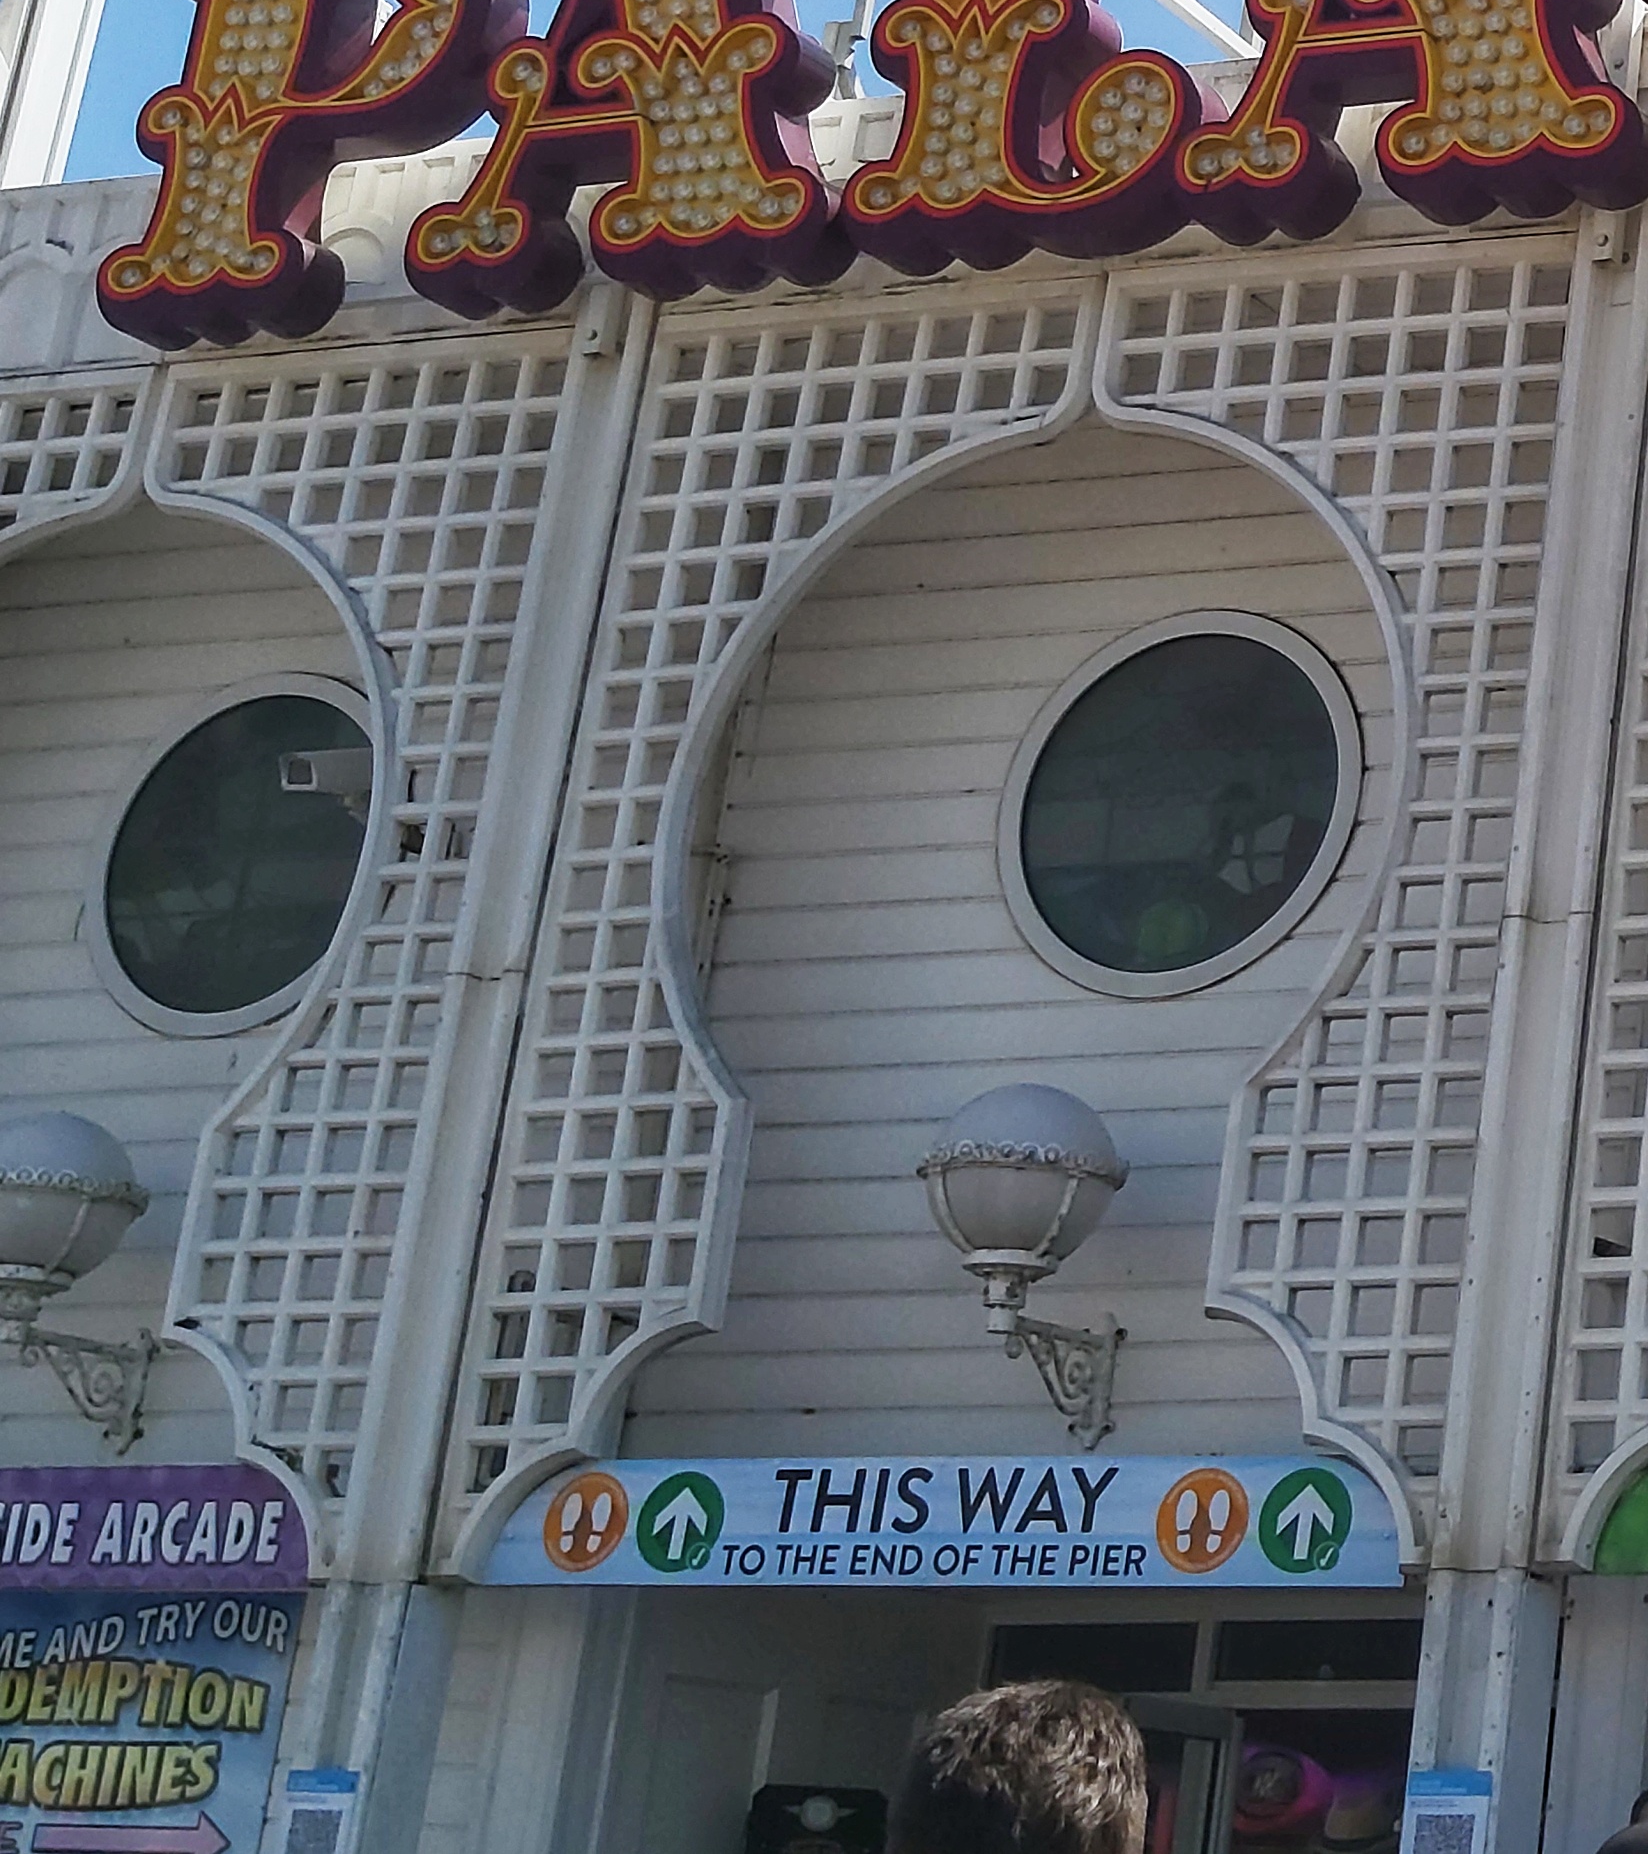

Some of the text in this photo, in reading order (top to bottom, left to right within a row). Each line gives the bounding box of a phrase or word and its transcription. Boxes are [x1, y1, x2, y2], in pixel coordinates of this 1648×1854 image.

[0, 1500, 285, 1564] IDE ARCADE
[775, 1466, 934, 1534] THIS
[957, 1465, 1120, 1534] WAY
[722, 1544, 1148, 1578] TO THE END OF THE PIER
[41, 1614, 126, 1666] AND
[137, 1600, 207, 1647] TRY
[213, 1599, 289, 1653] OUR
